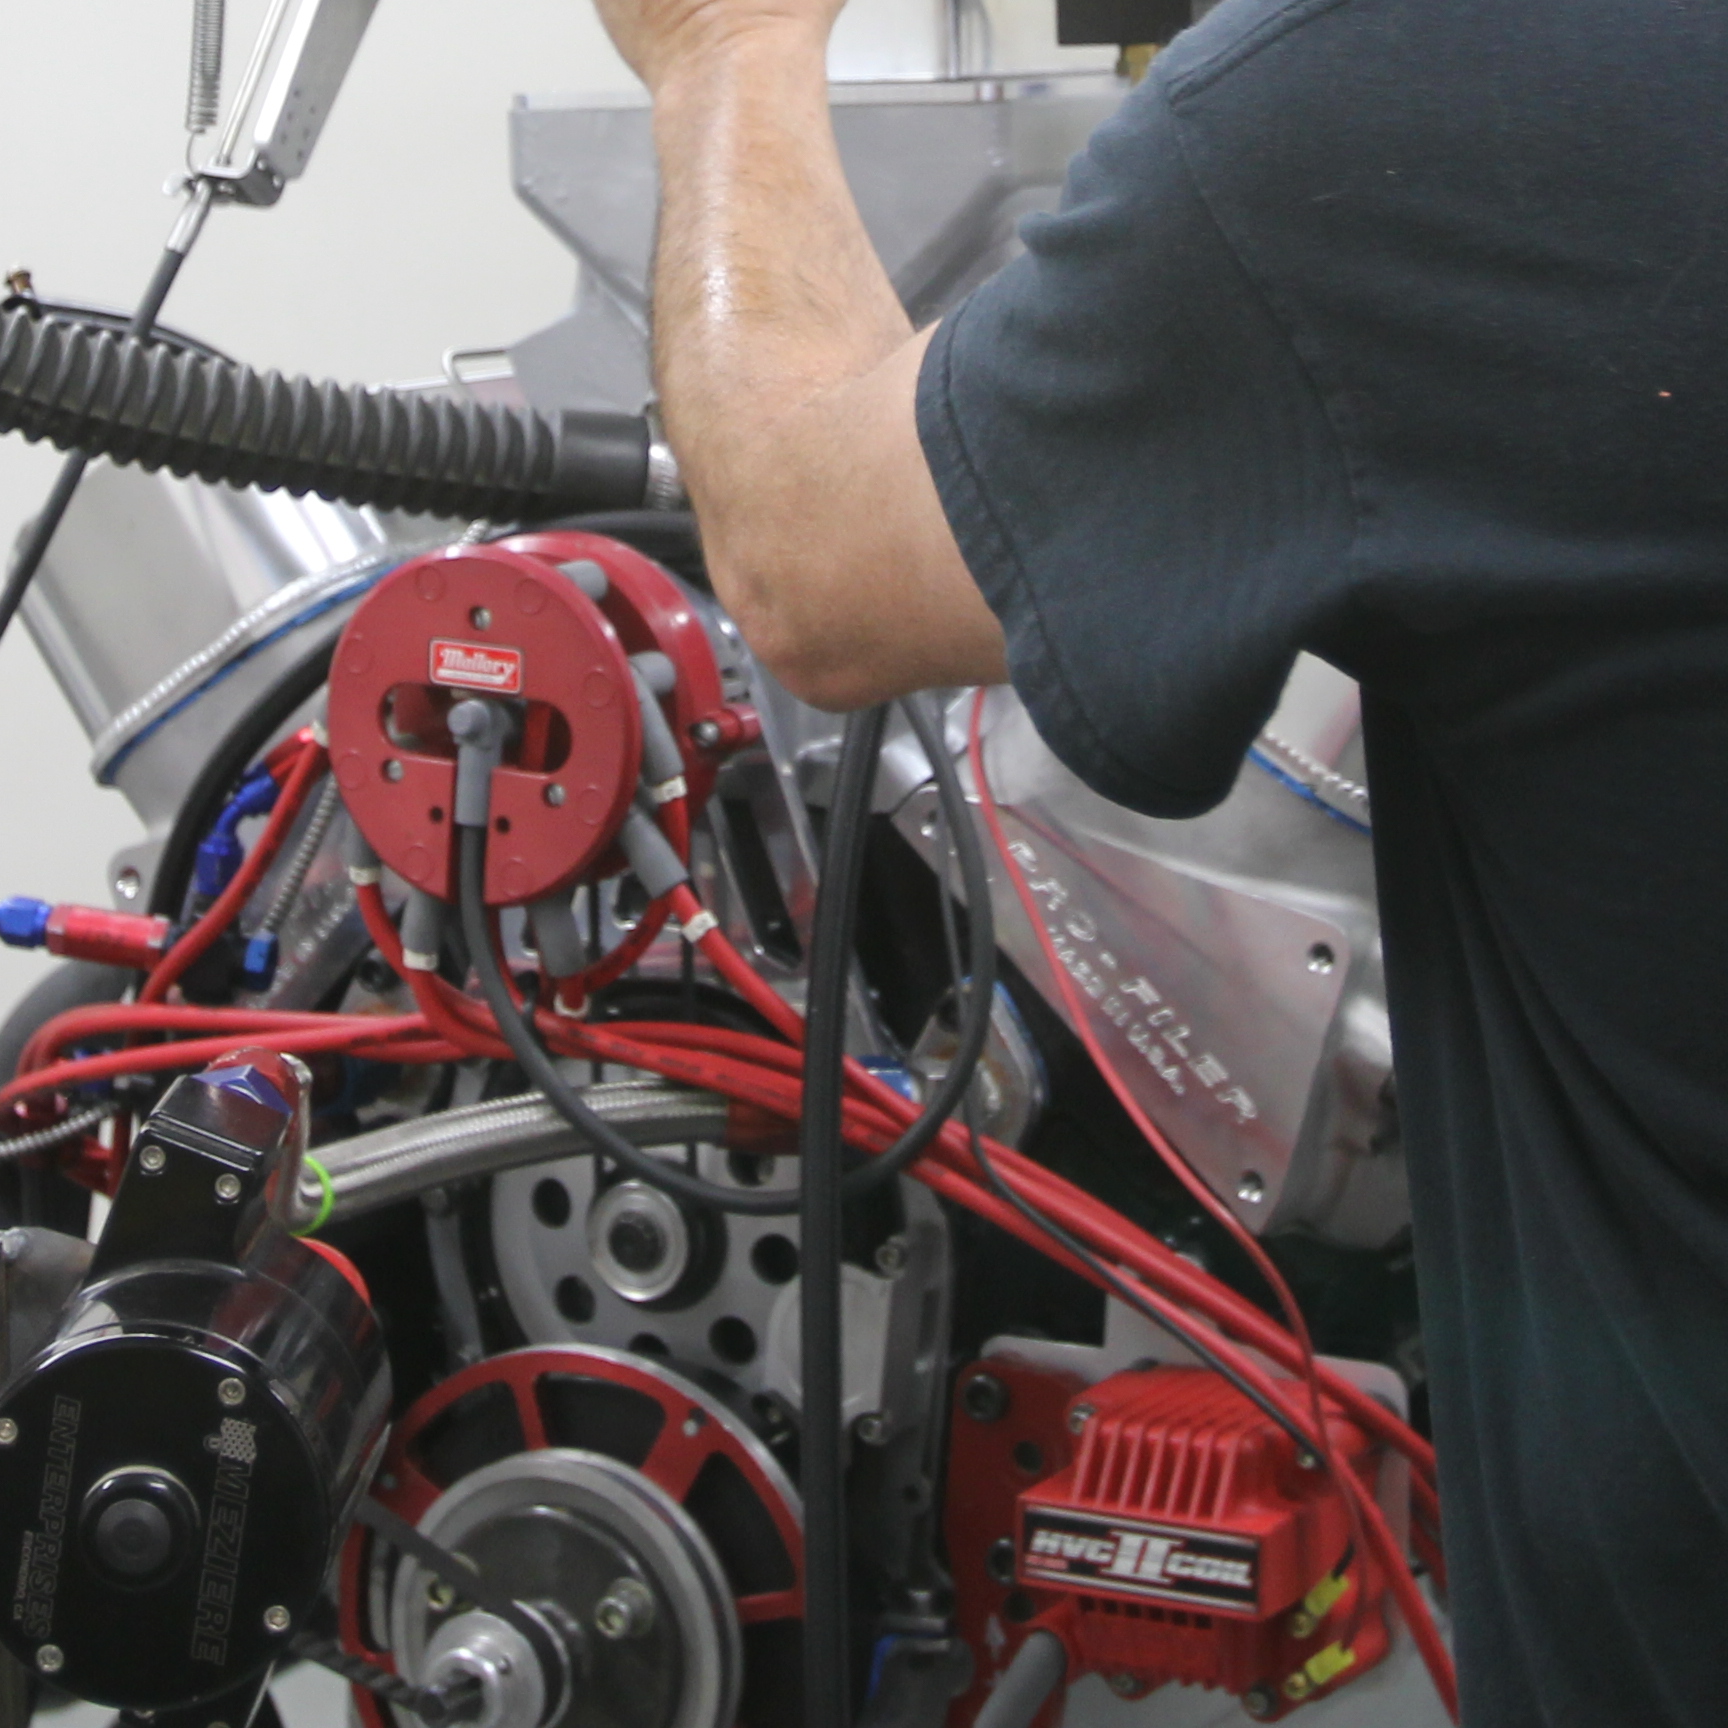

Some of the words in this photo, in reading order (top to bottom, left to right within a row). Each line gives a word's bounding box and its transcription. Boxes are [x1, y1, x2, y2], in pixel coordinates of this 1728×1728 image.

[439, 647, 517, 685] Mallory
[21, 1393, 83, 1640] ENTERPRISES
[189, 1456, 253, 1667] MEZIERE
[1029, 1528, 1116, 1565] HVC
[1164, 1551, 1255, 1587] COIL
